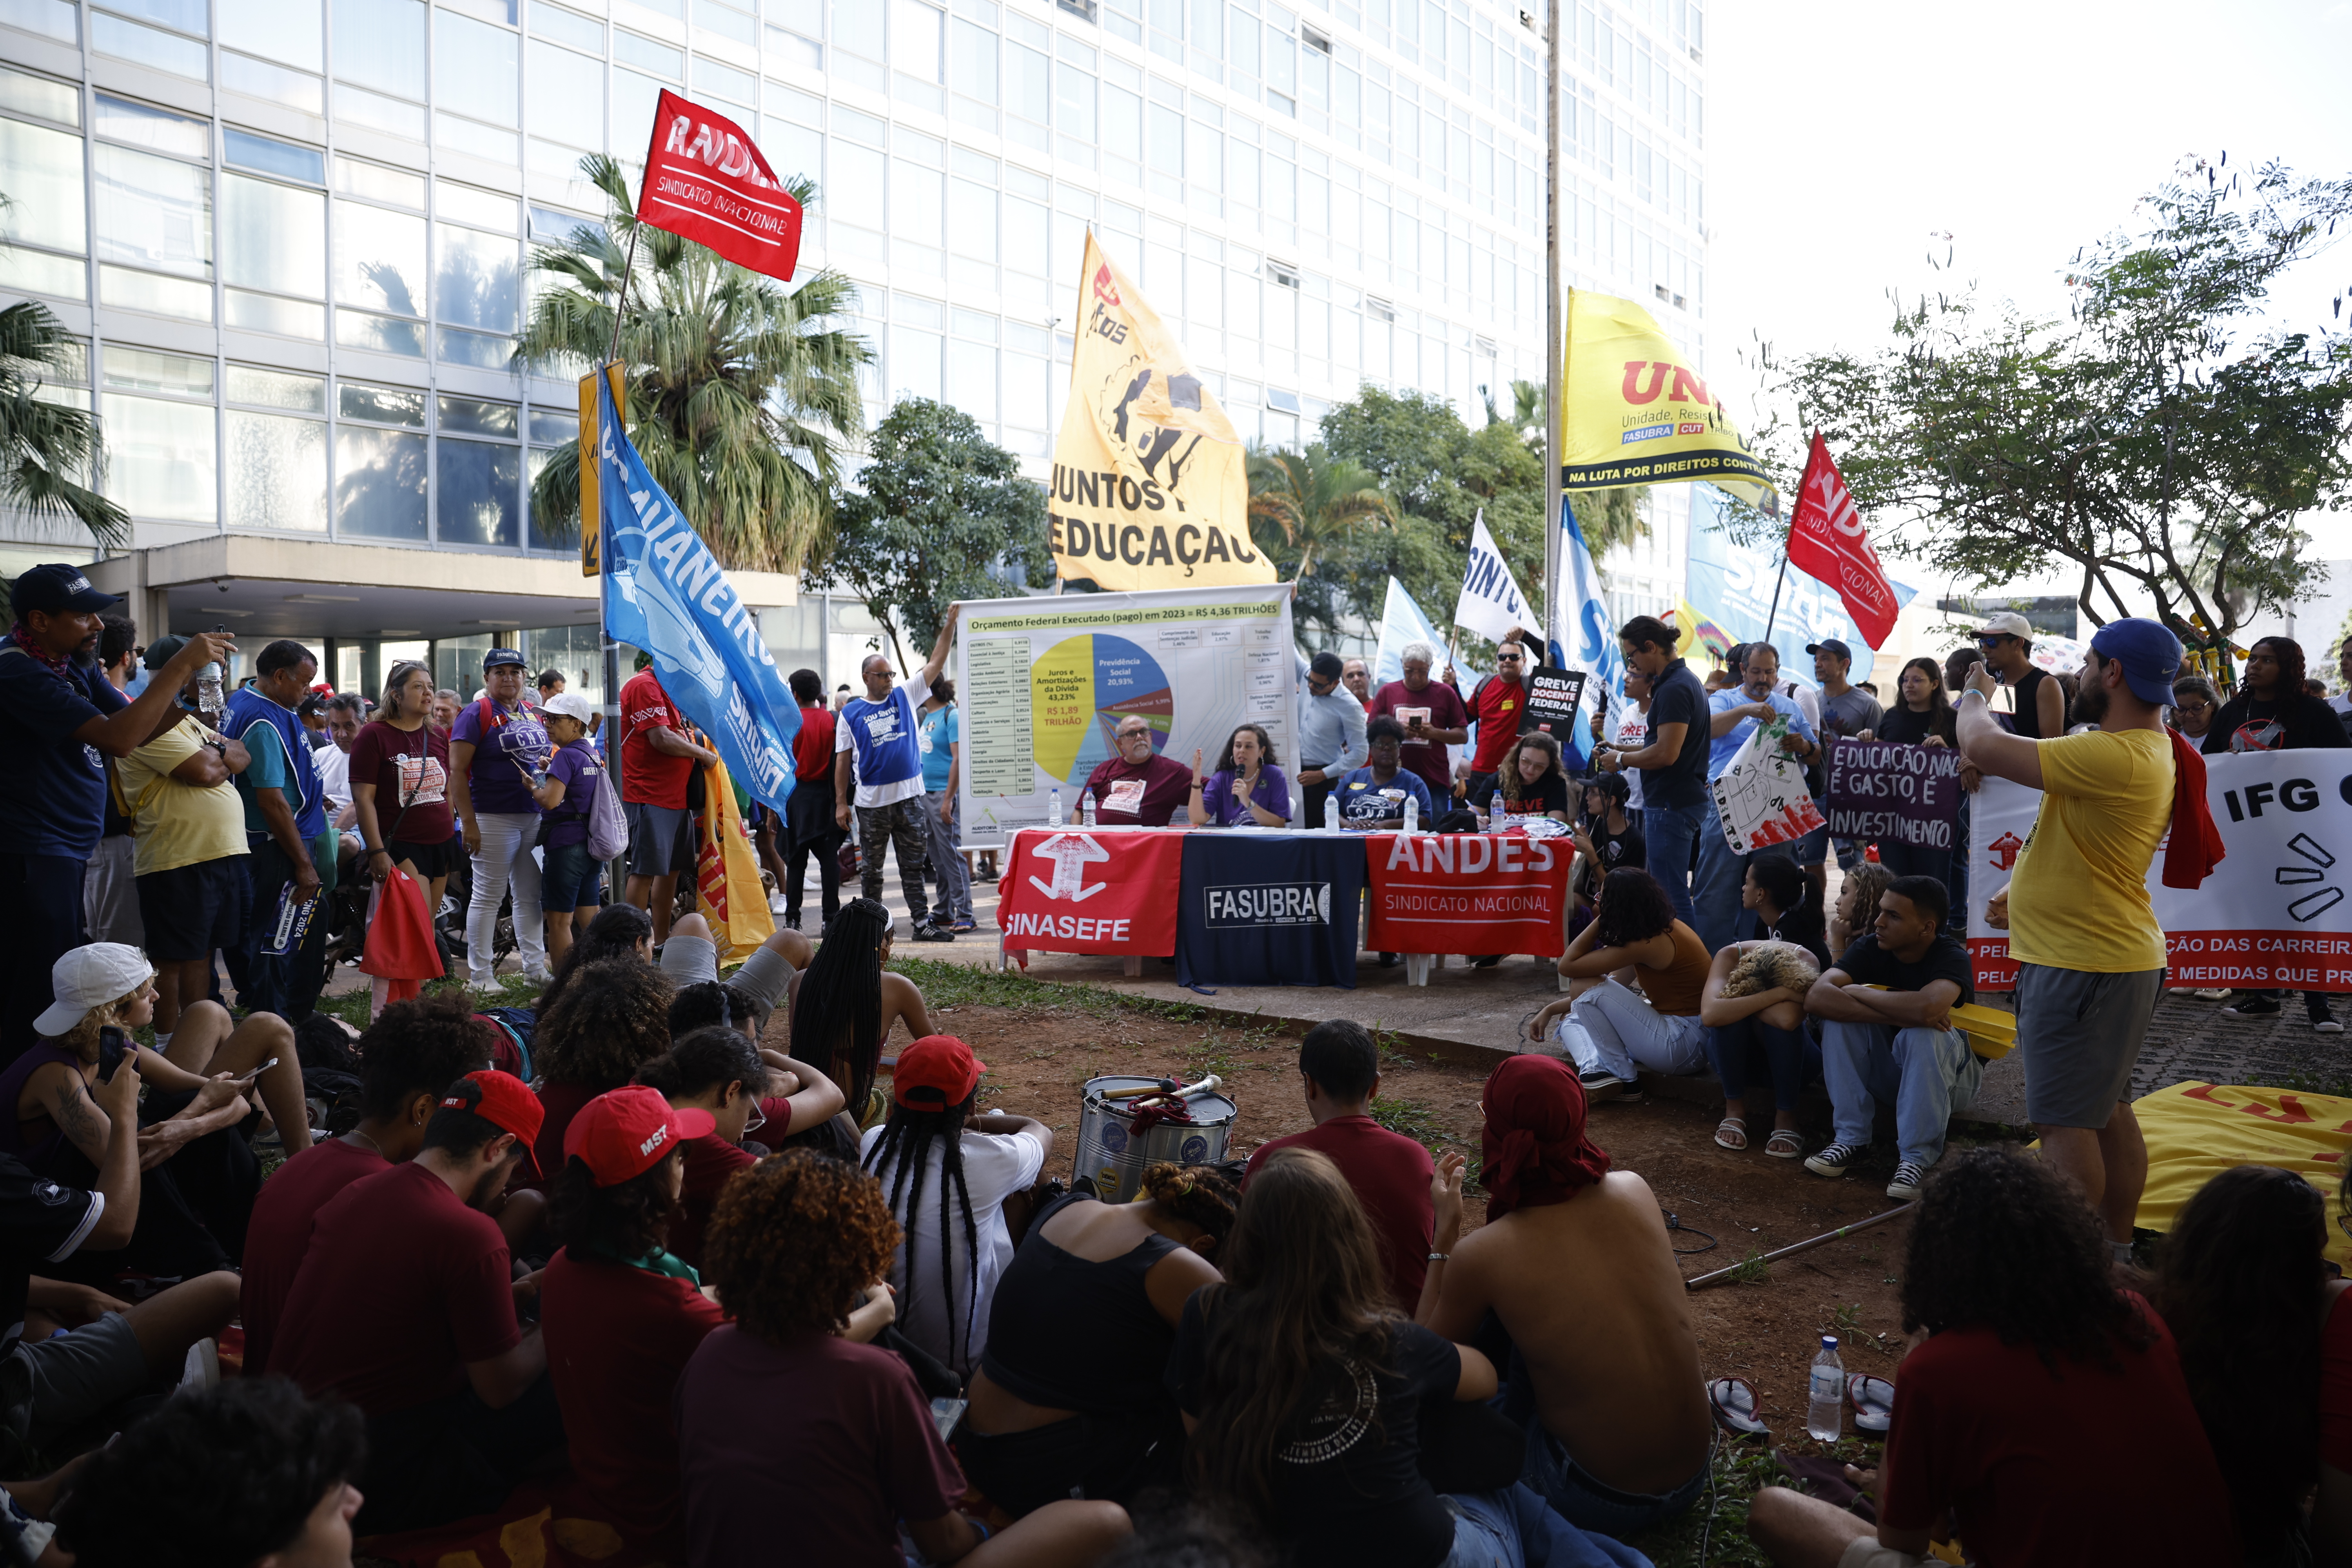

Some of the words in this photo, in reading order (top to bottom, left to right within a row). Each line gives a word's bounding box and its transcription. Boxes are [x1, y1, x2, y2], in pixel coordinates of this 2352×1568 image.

[657, 176, 712, 205] SINDICATO
[714, 196, 787, 235] NACIONAL
[1622, 410, 1673, 428] Unidade,
[1624, 426, 1671, 443] FASUBRA
[1681, 424, 1702, 433] CUT
[1569, 473, 1586, 482] NA
[1589, 468, 1621, 481] LUTA
[1624, 466, 1650, 477] POR
[1654, 457, 1719, 475] DIREITOS
[1049, 463, 1165, 512] JUNTOS
[1463, 547, 1522, 620] SINTU
[972, 619, 1023, 630] Orçamento
[1025, 616, 1060, 626] Federal
[1062, 614, 1110, 623] Executado
[1112, 612, 1142, 622] (pago)
[1162, 610, 1185, 618] 2023
[1196, 608, 1207, 617] R$
[1210, 606, 1230, 616] 4,36
[1232, 604, 1277, 615] TRILHÕES
[1100, 658, 1140, 666] Previdência
[1036, 677, 1086, 685] Amortizações
[1534, 676, 1579, 692] GREVE
[1529, 697, 1573, 711] FEDERAL
[1532, 688, 1576, 701] DOCENTE
[1047, 707, 1058, 716] R$
[1060, 706, 1078, 715] 1,89
[1112, 702, 1138, 711] Assistência
[863, 713, 878, 724] SOU
[1044, 716, 1082, 726] TRILHÃO
[1834, 744, 1929, 777] EDUCAÇÃO
[1930, 747, 1960, 777] NÃO
[583, 767, 596, 775] GREVE
[1831, 768, 1840, 794] É
[1849, 774, 1916, 804] GASTO,
[1923, 775, 1935, 805] É
[2224, 779, 2320, 822] IFG
[1829, 809, 1952, 849] INVESTIMENTO.
[1386, 835, 1555, 874] ANDES
[301, 899, 314, 915] CNG
[1210, 887, 1317, 919] FASUBRA
[1386, 894, 1468, 913] SINDICATO
[1474, 895, 1551, 913] NACIONAL
[280, 919, 290, 938] SALARIAL
[294, 916, 307, 938] 2024
[1005, 913, 1130, 941] SINASEFE
[1980, 945, 2009, 958] PEL
[2210, 938, 2250, 952] DAS
[2180, 966, 2269, 980] MEDIDAS
[2275, 967, 2319, 983] QUE
[2326, 969, 2352, 984] PR
[640, 1123, 669, 1157] MST
[1332, 1435, 1347, 1448] DE
[1345, 1417, 1363, 1439] 192
